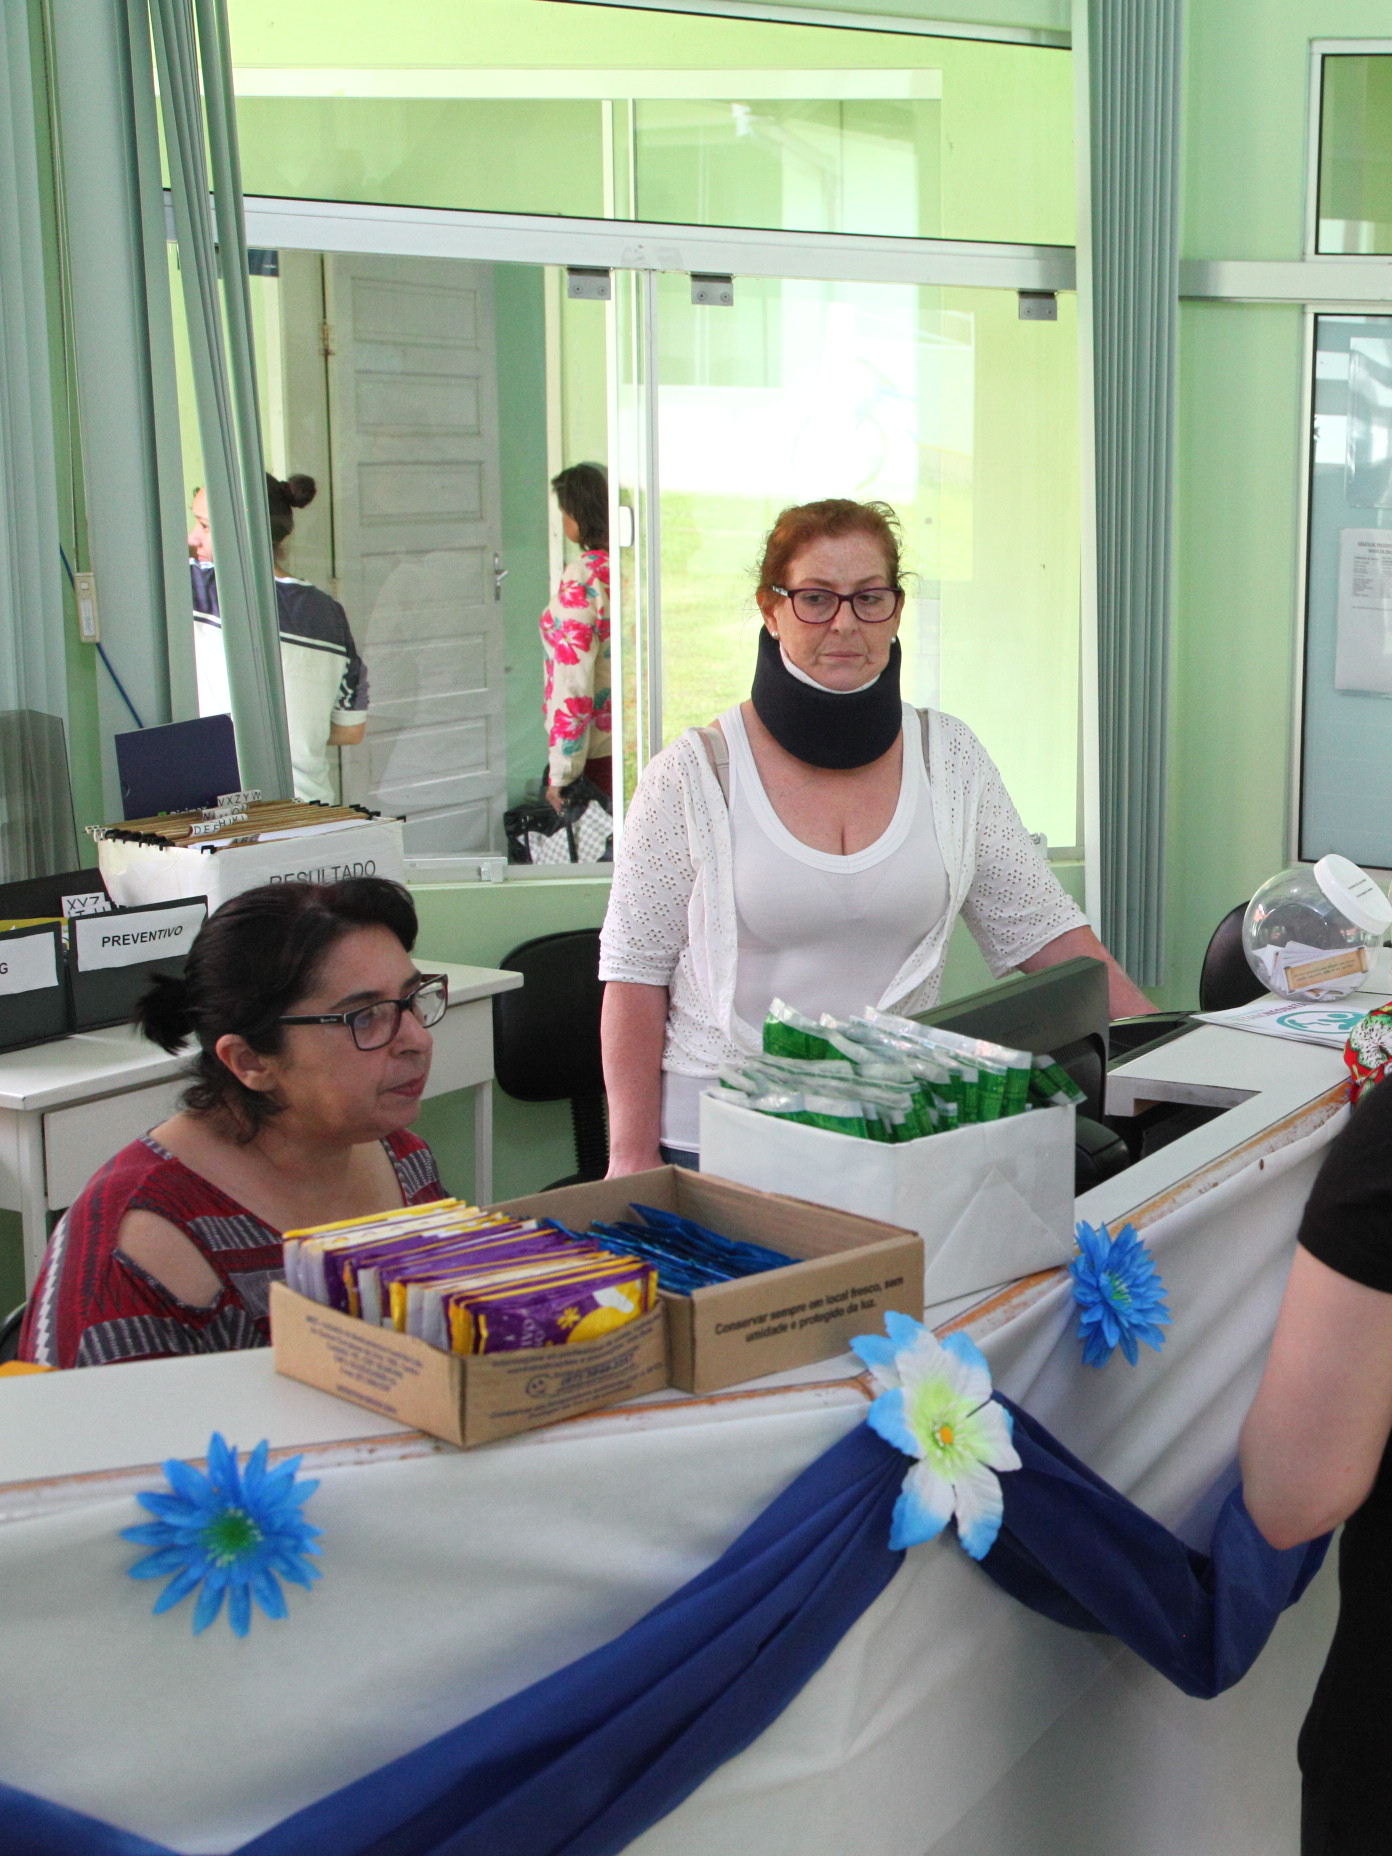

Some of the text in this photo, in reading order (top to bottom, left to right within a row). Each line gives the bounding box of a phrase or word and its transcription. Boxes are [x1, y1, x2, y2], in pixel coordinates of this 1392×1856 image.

[102, 925, 183, 947] PREVENTIVO
[714, 1313, 768, 1335] Conservar
[770, 1303, 807, 1322] sempre
[808, 1298, 824, 1309] em
[825, 1292, 849, 1304] local
[745, 1322, 788, 1342] umidade
[798, 1307, 845, 1330] protegido
